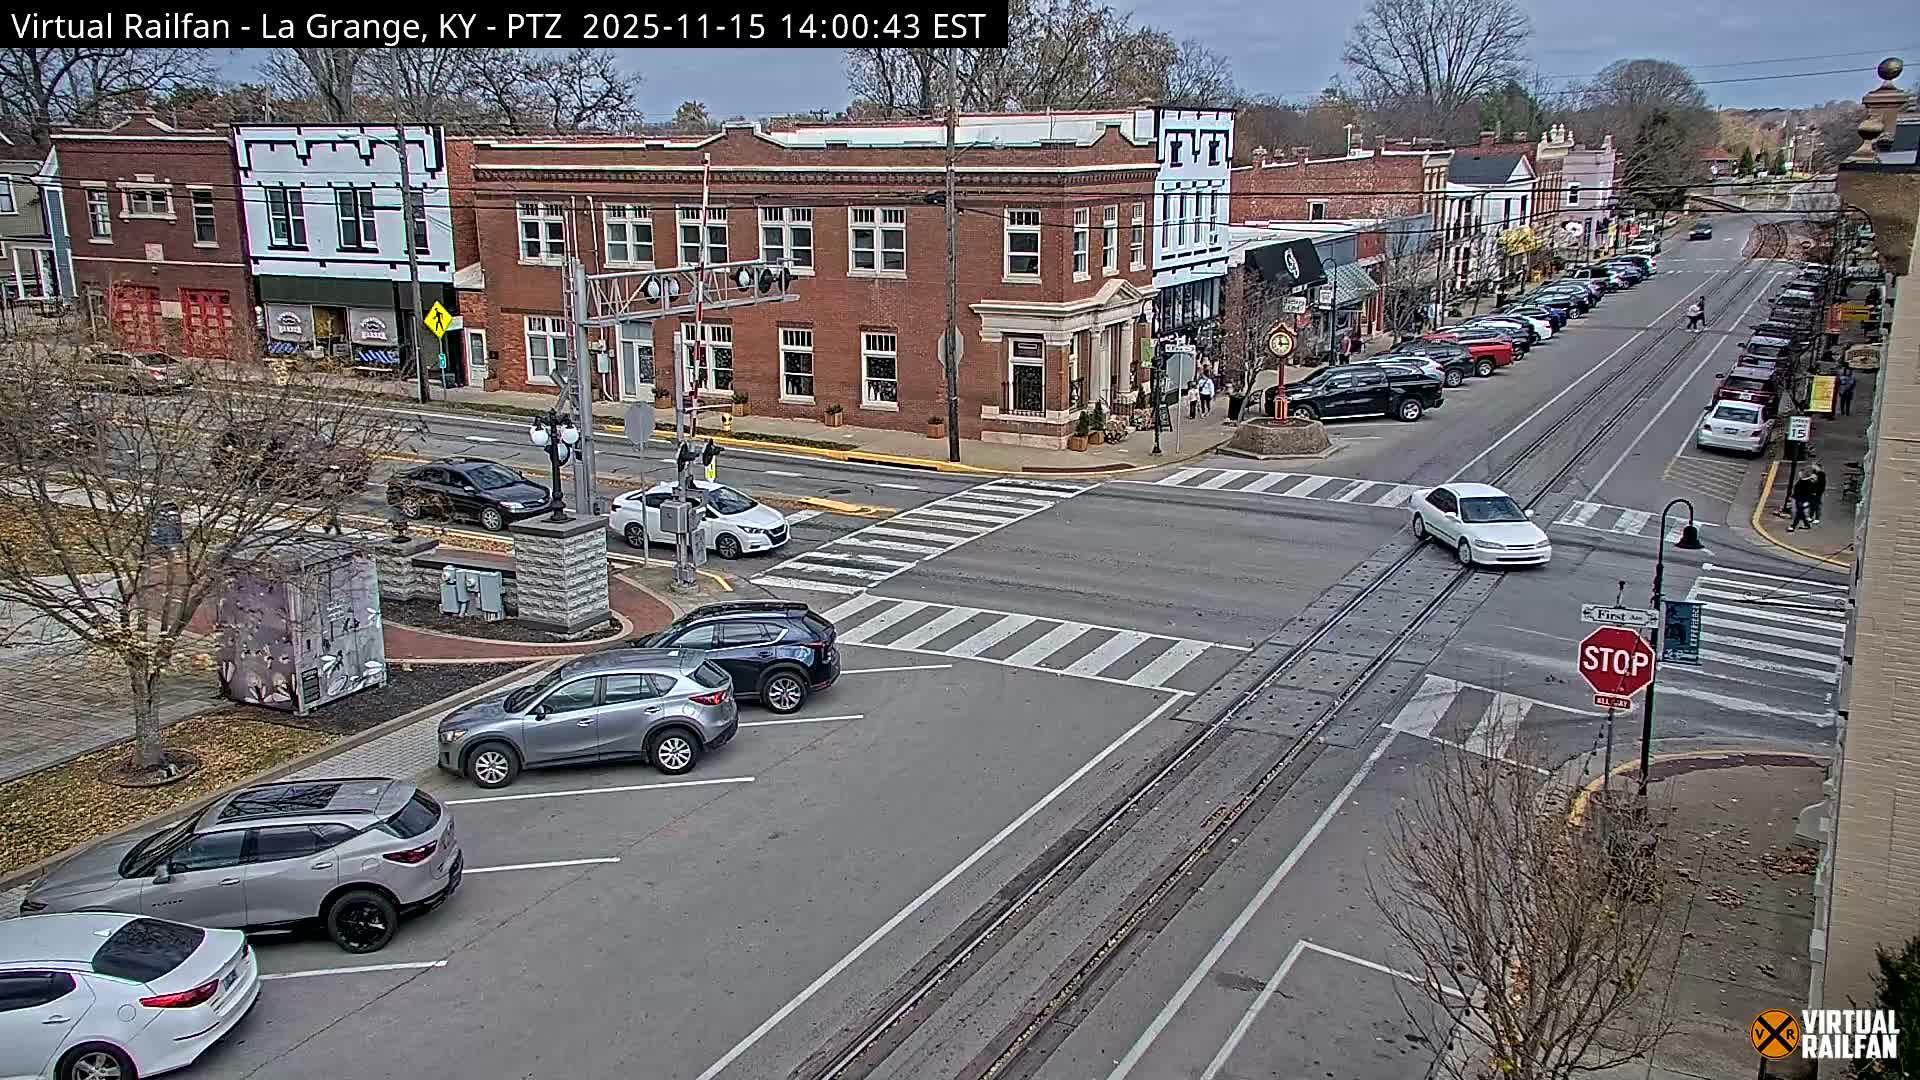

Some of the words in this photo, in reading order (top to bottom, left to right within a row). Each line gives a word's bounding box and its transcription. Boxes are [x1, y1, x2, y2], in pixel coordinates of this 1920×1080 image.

[1792, 429, 1806, 438] 15
[1598, 609, 1626, 621] First
[1583, 646, 1649, 677] STOP
